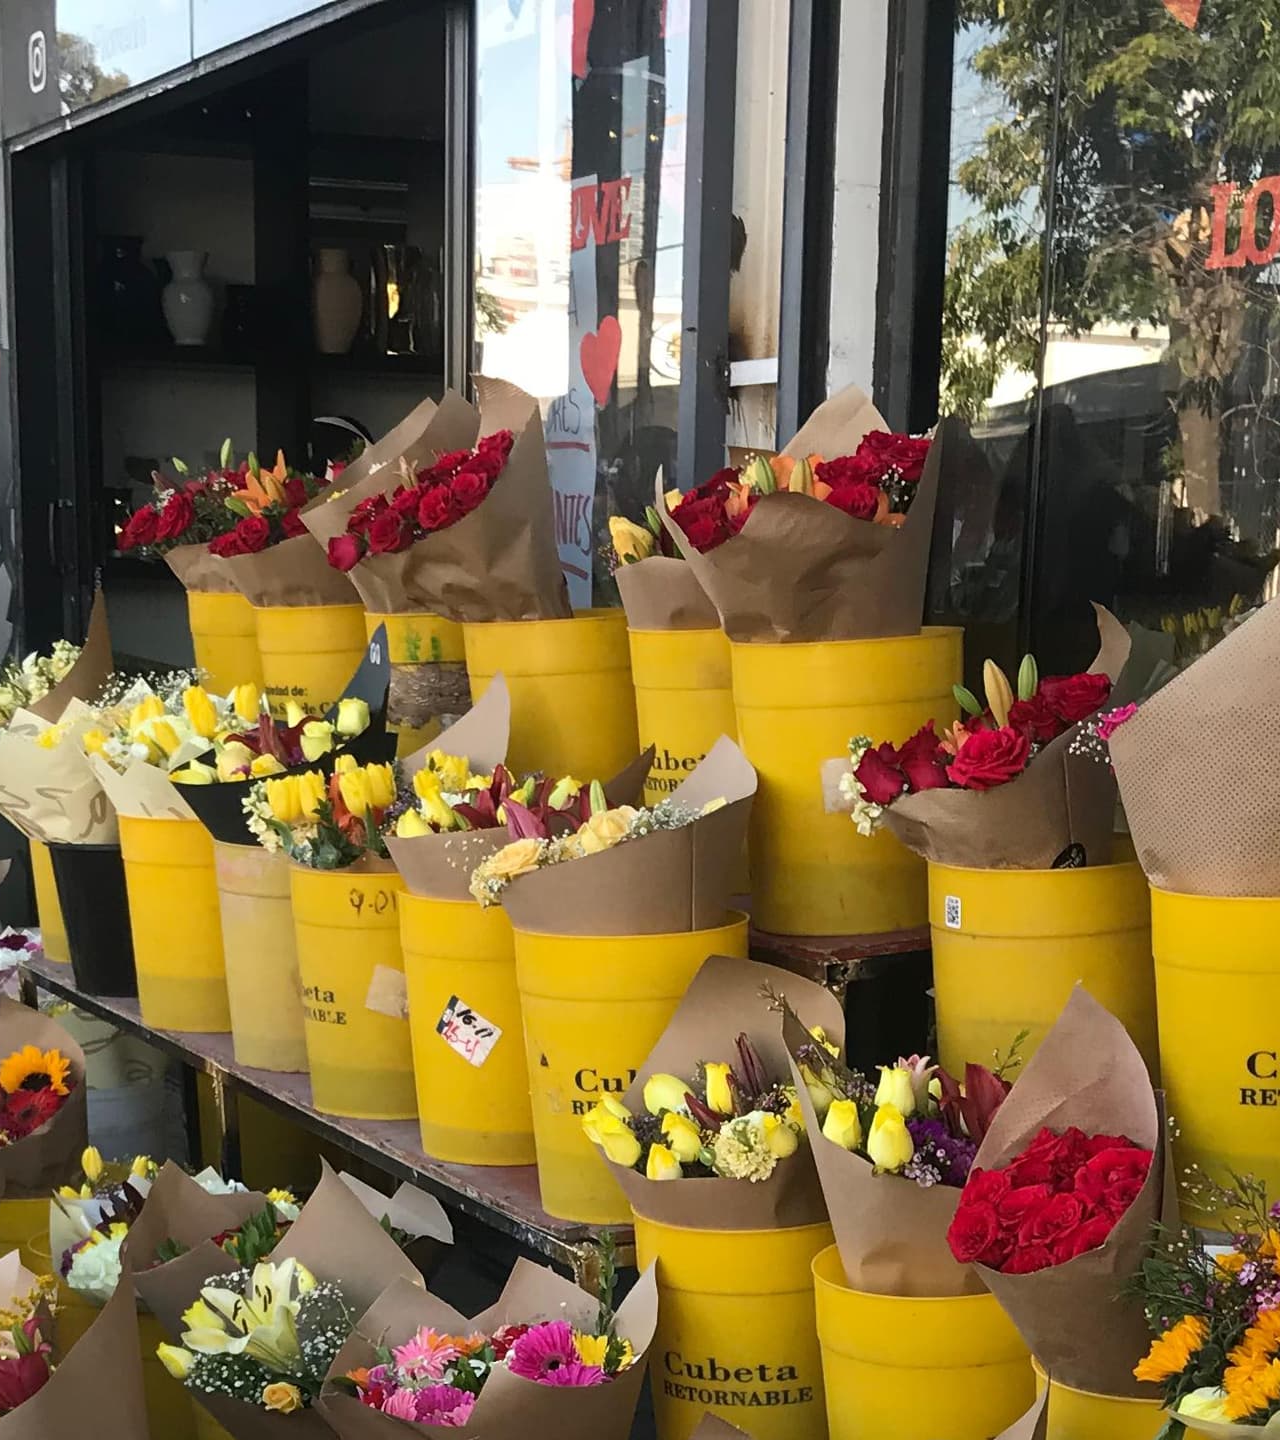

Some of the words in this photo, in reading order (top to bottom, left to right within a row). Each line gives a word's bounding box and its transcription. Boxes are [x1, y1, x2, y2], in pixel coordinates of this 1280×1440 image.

[571, 177, 632, 250] OVE
[555, 490, 593, 556] NTES
[663, 1351, 799, 1383] Cubeta
[663, 1378, 814, 1407] RETORNABLE
